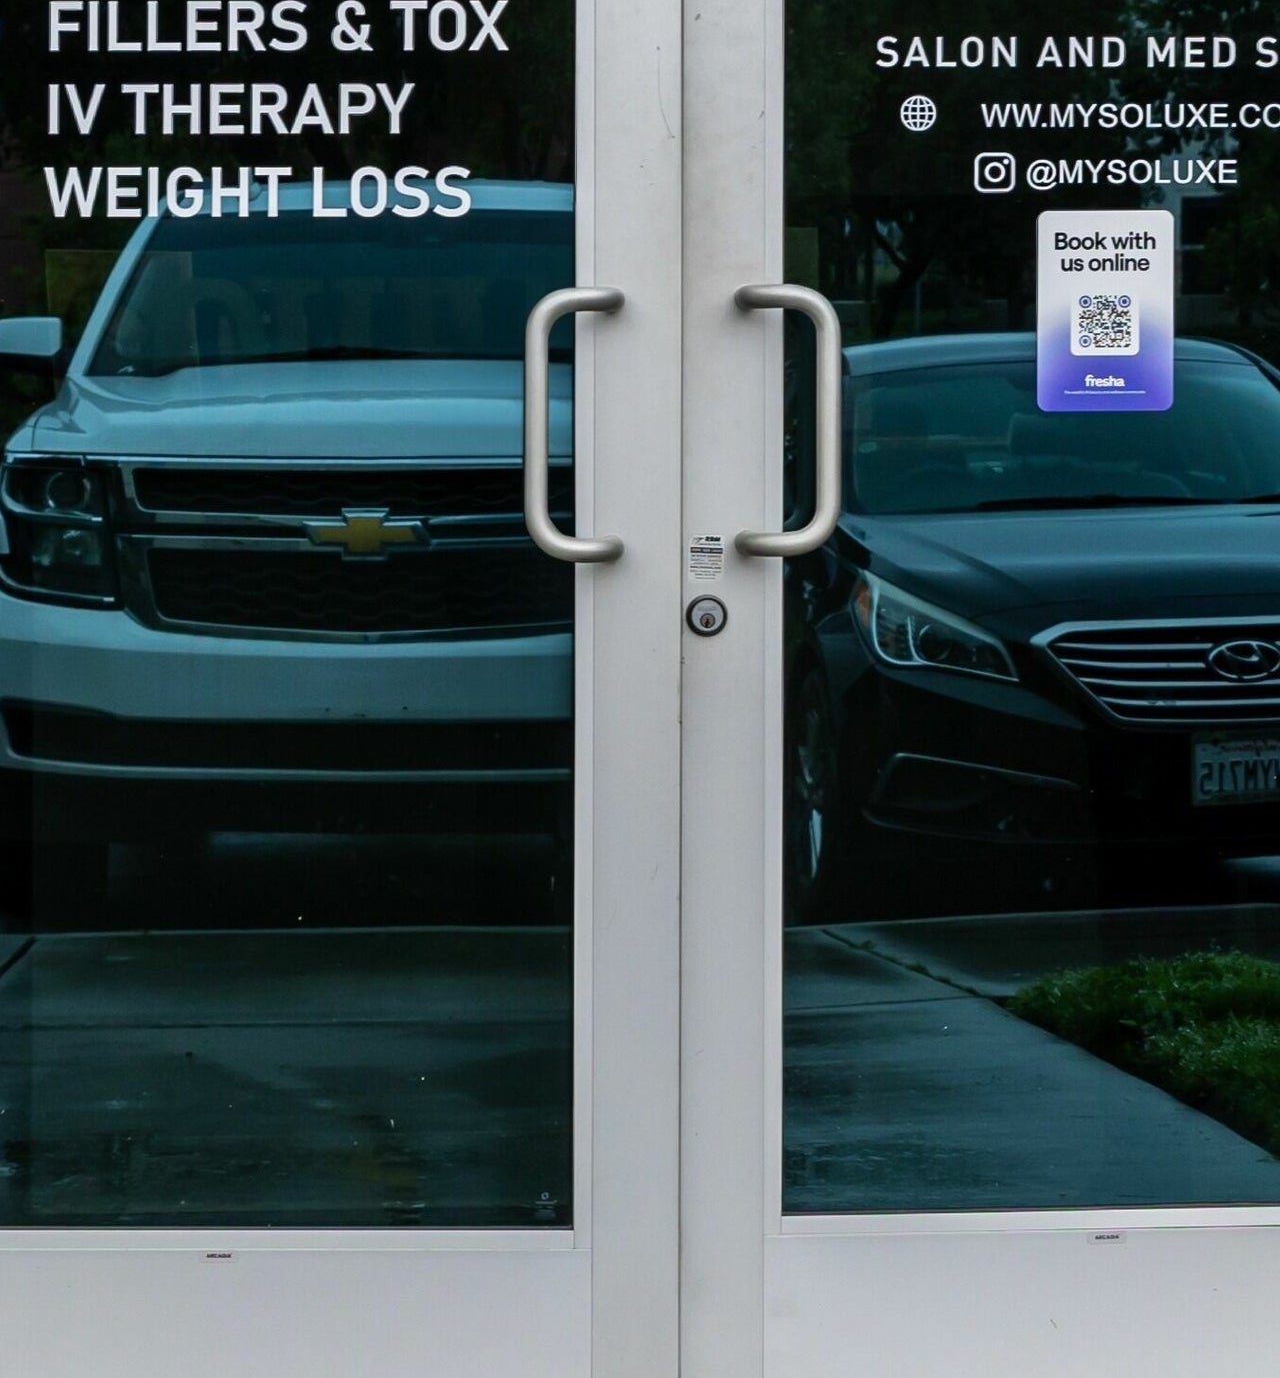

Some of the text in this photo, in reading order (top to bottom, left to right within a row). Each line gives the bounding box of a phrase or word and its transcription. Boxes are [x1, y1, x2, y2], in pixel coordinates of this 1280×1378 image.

[50, 0, 508, 51] FILLERS & TOX
[877, 37, 1016, 67] SALON
[1037, 37, 1124, 67] AND
[1148, 37, 1235, 67] MED
[49, 84, 414, 134] IV THERAPY
[1027, 160, 1237, 190] @MYSOLUXE
[45, 167, 470, 217] WEIGHT LOSS
[1055, 232, 1155, 250] Book with
[1061, 253, 1149, 271] us online
[1084, 374, 1126, 387] fresha
